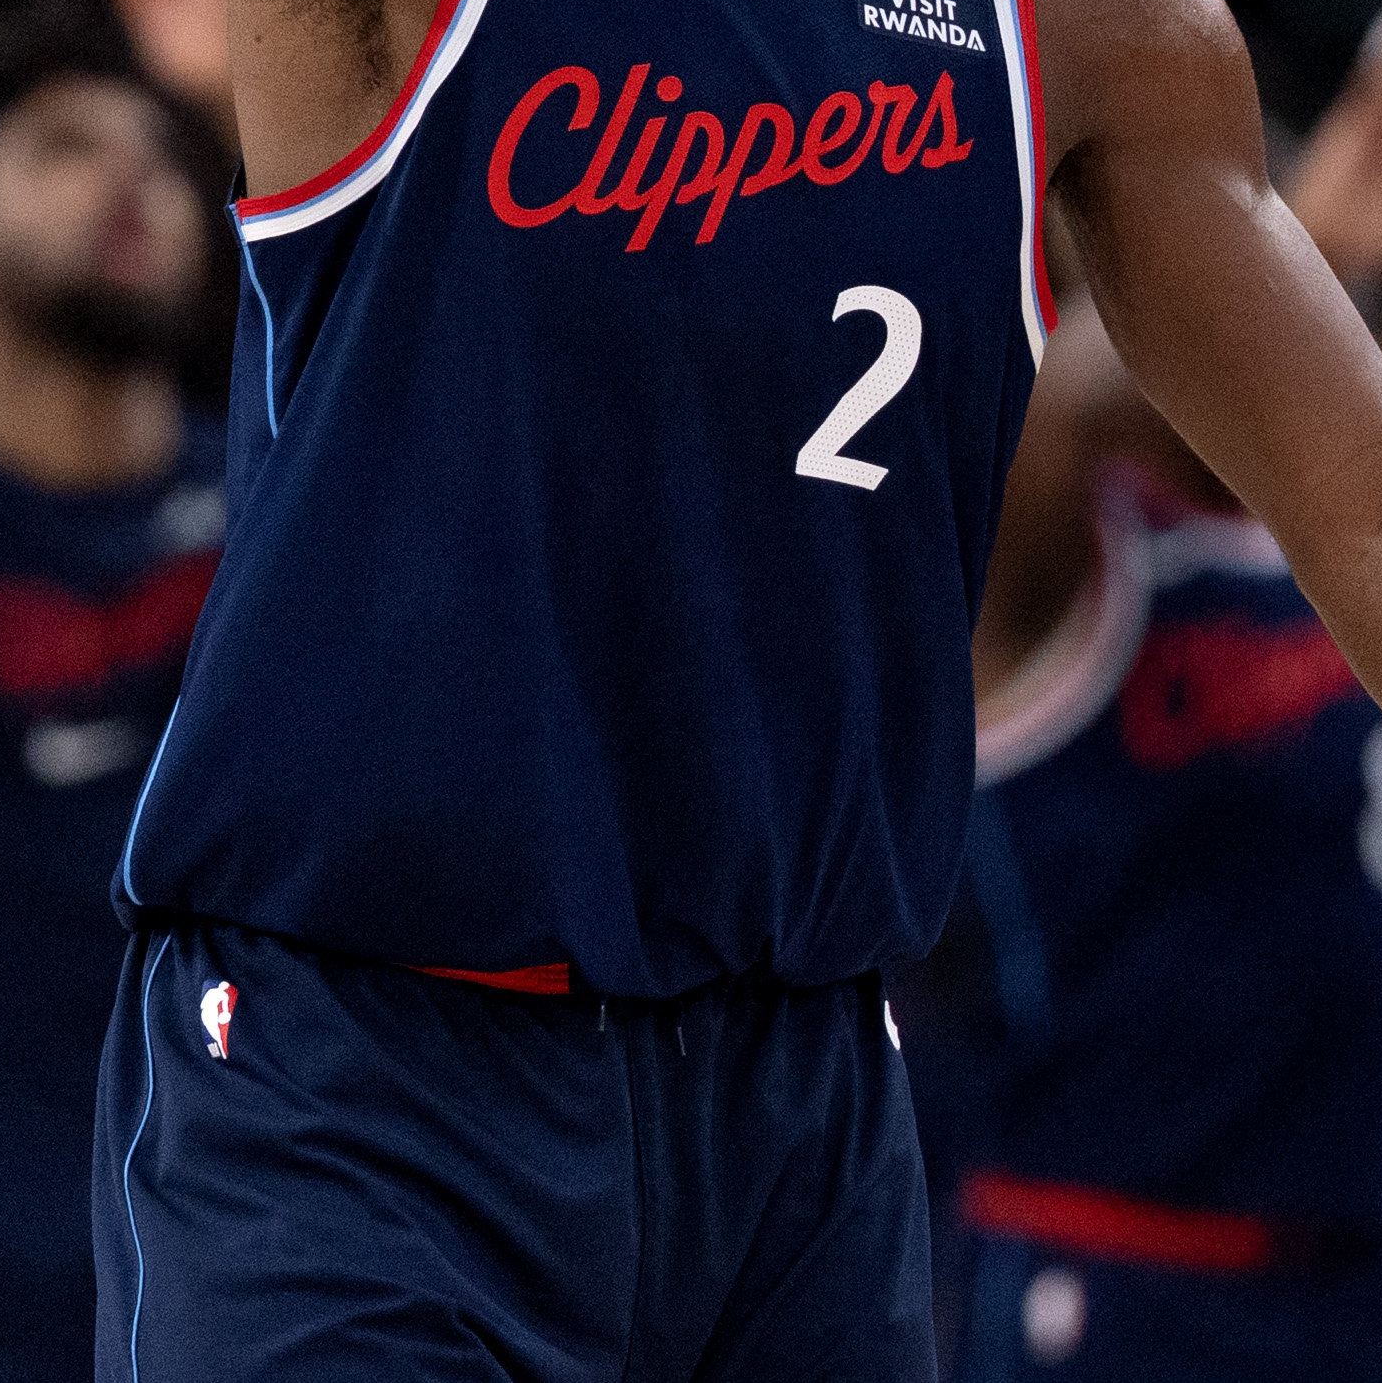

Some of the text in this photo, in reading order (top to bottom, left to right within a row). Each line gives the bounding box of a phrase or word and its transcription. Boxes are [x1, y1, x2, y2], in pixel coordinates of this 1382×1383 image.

[863, 3, 986, 52] RWANDA
[487, 62, 974, 253] Clippers
[794, 284, 923, 492] 2
